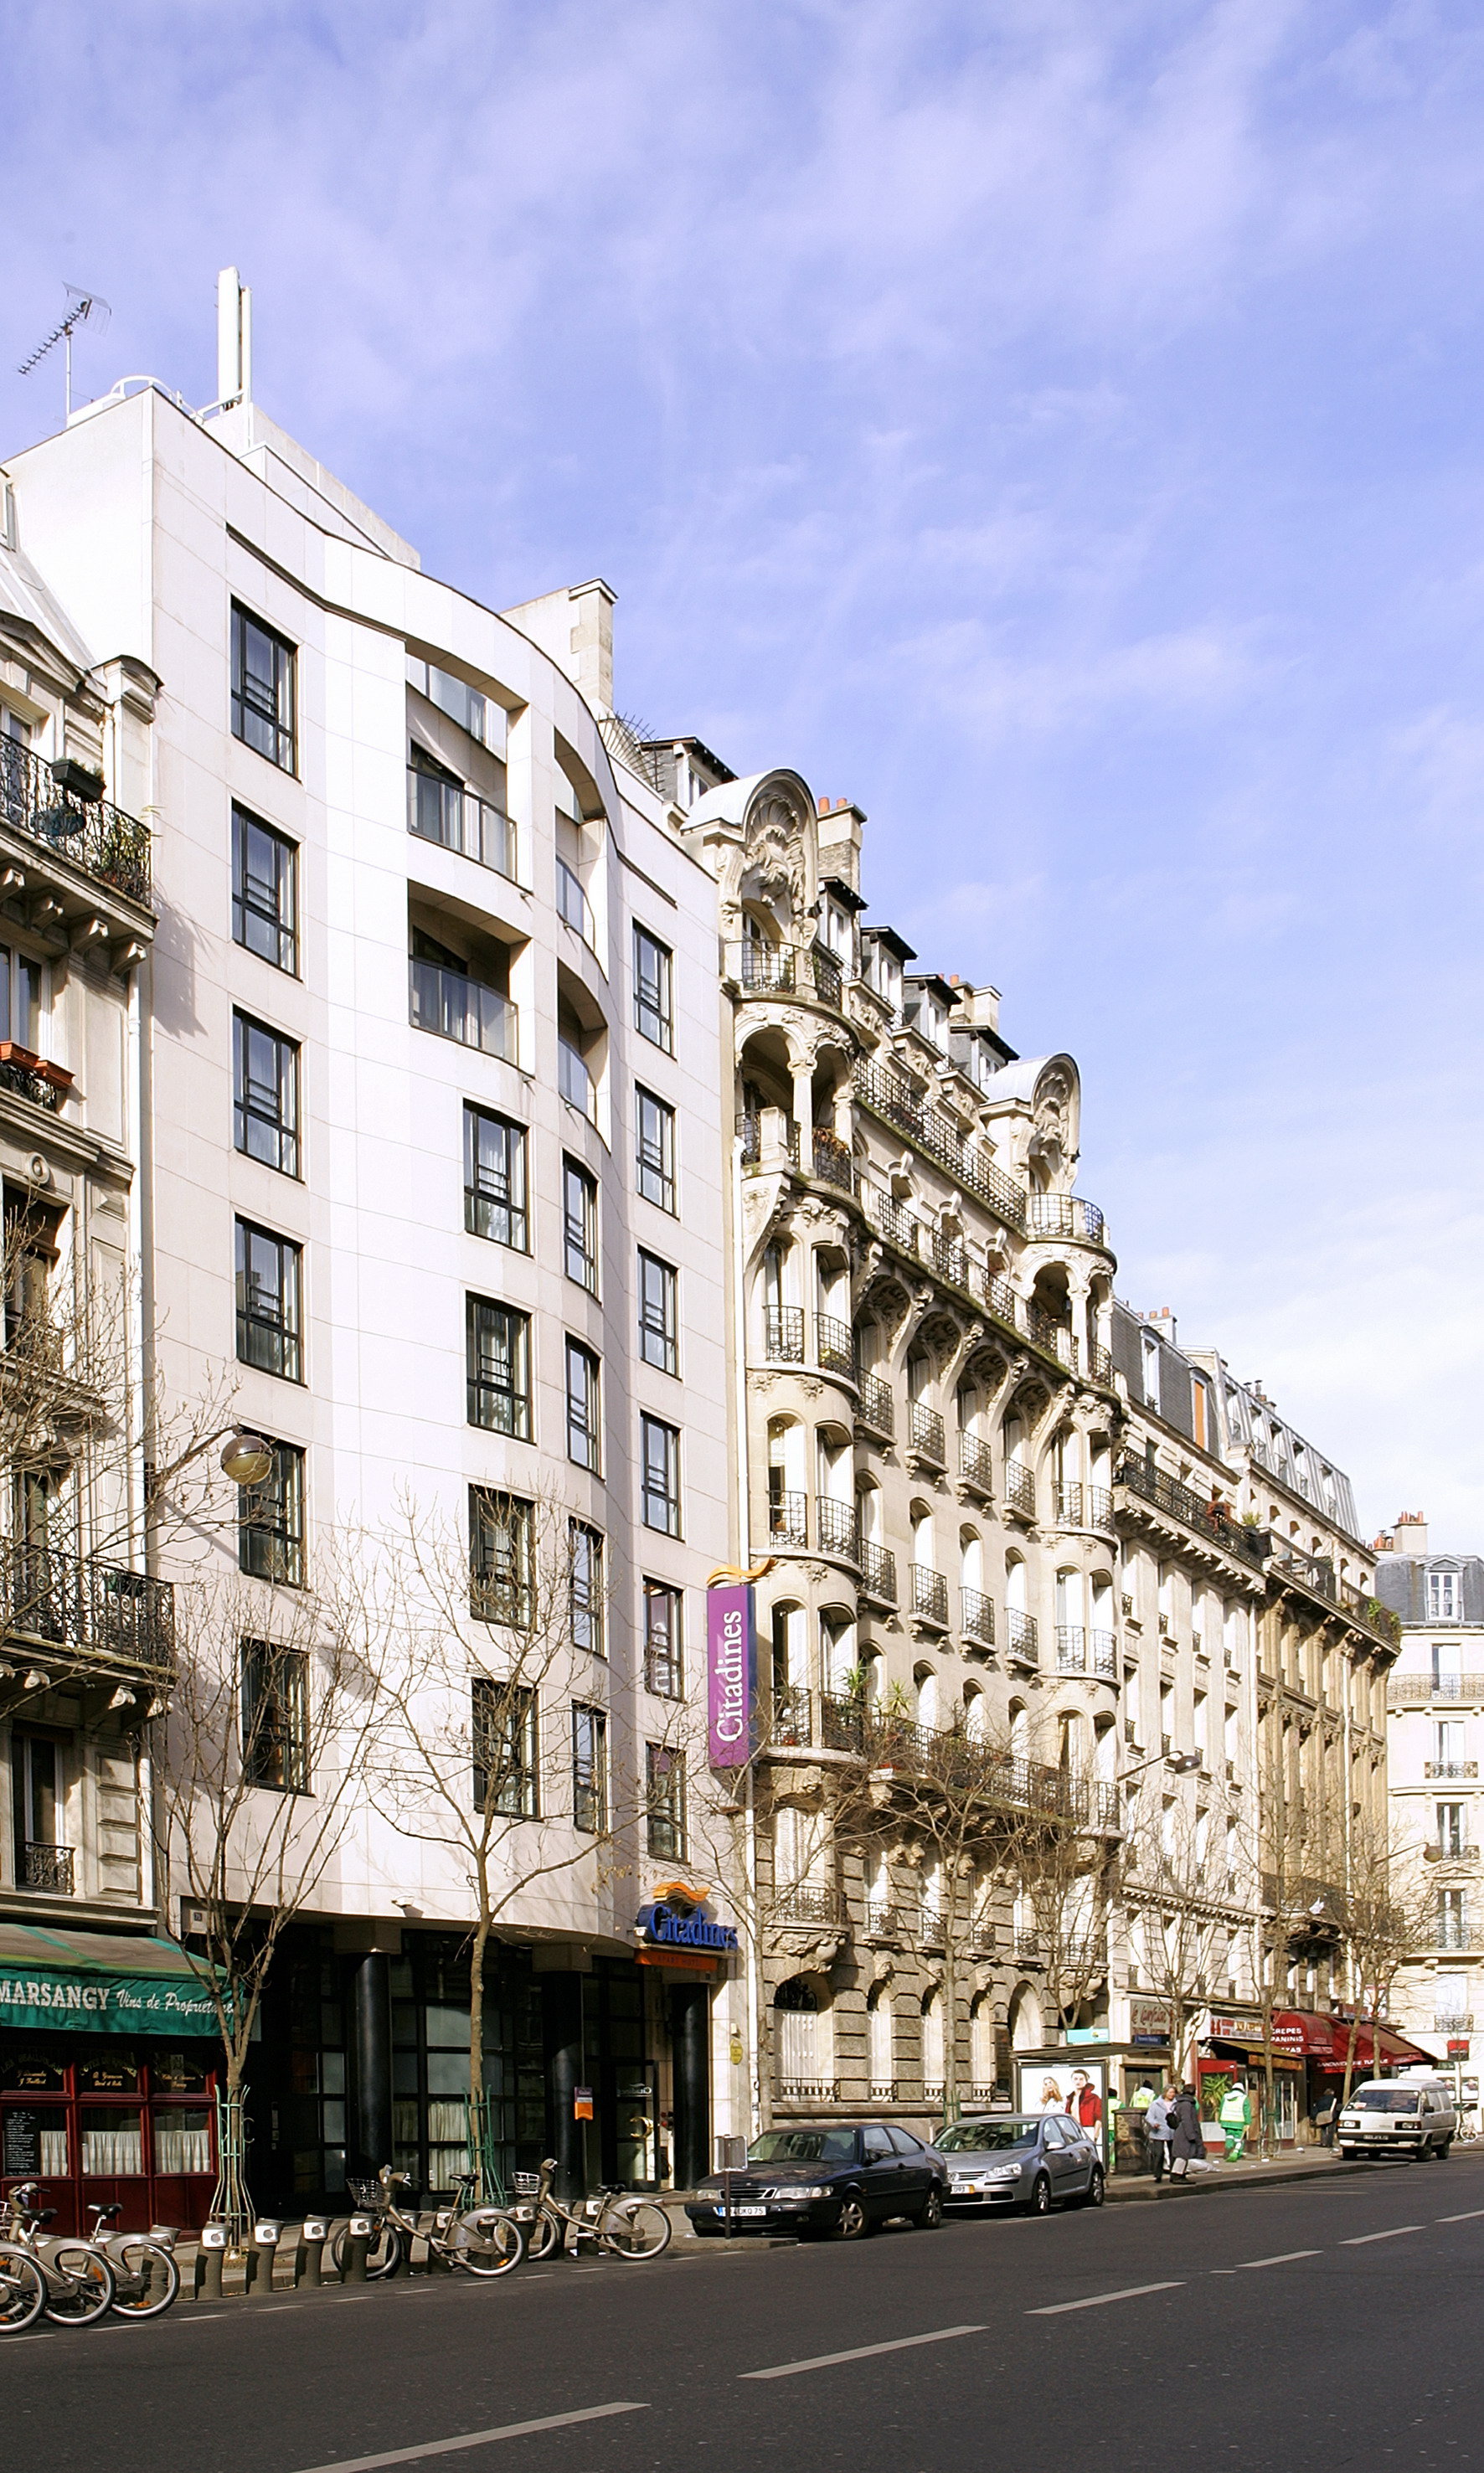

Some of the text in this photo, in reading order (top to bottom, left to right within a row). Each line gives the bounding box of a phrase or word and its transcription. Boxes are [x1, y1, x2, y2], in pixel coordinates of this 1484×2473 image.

[714, 1610, 744, 1742] Citadines
[650, 1904, 738, 1950] Citadines
[0, 1980, 110, 2010] MARSANGY
[116, 1988, 142, 2008] Vins
[147, 1993, 161, 2009] de
